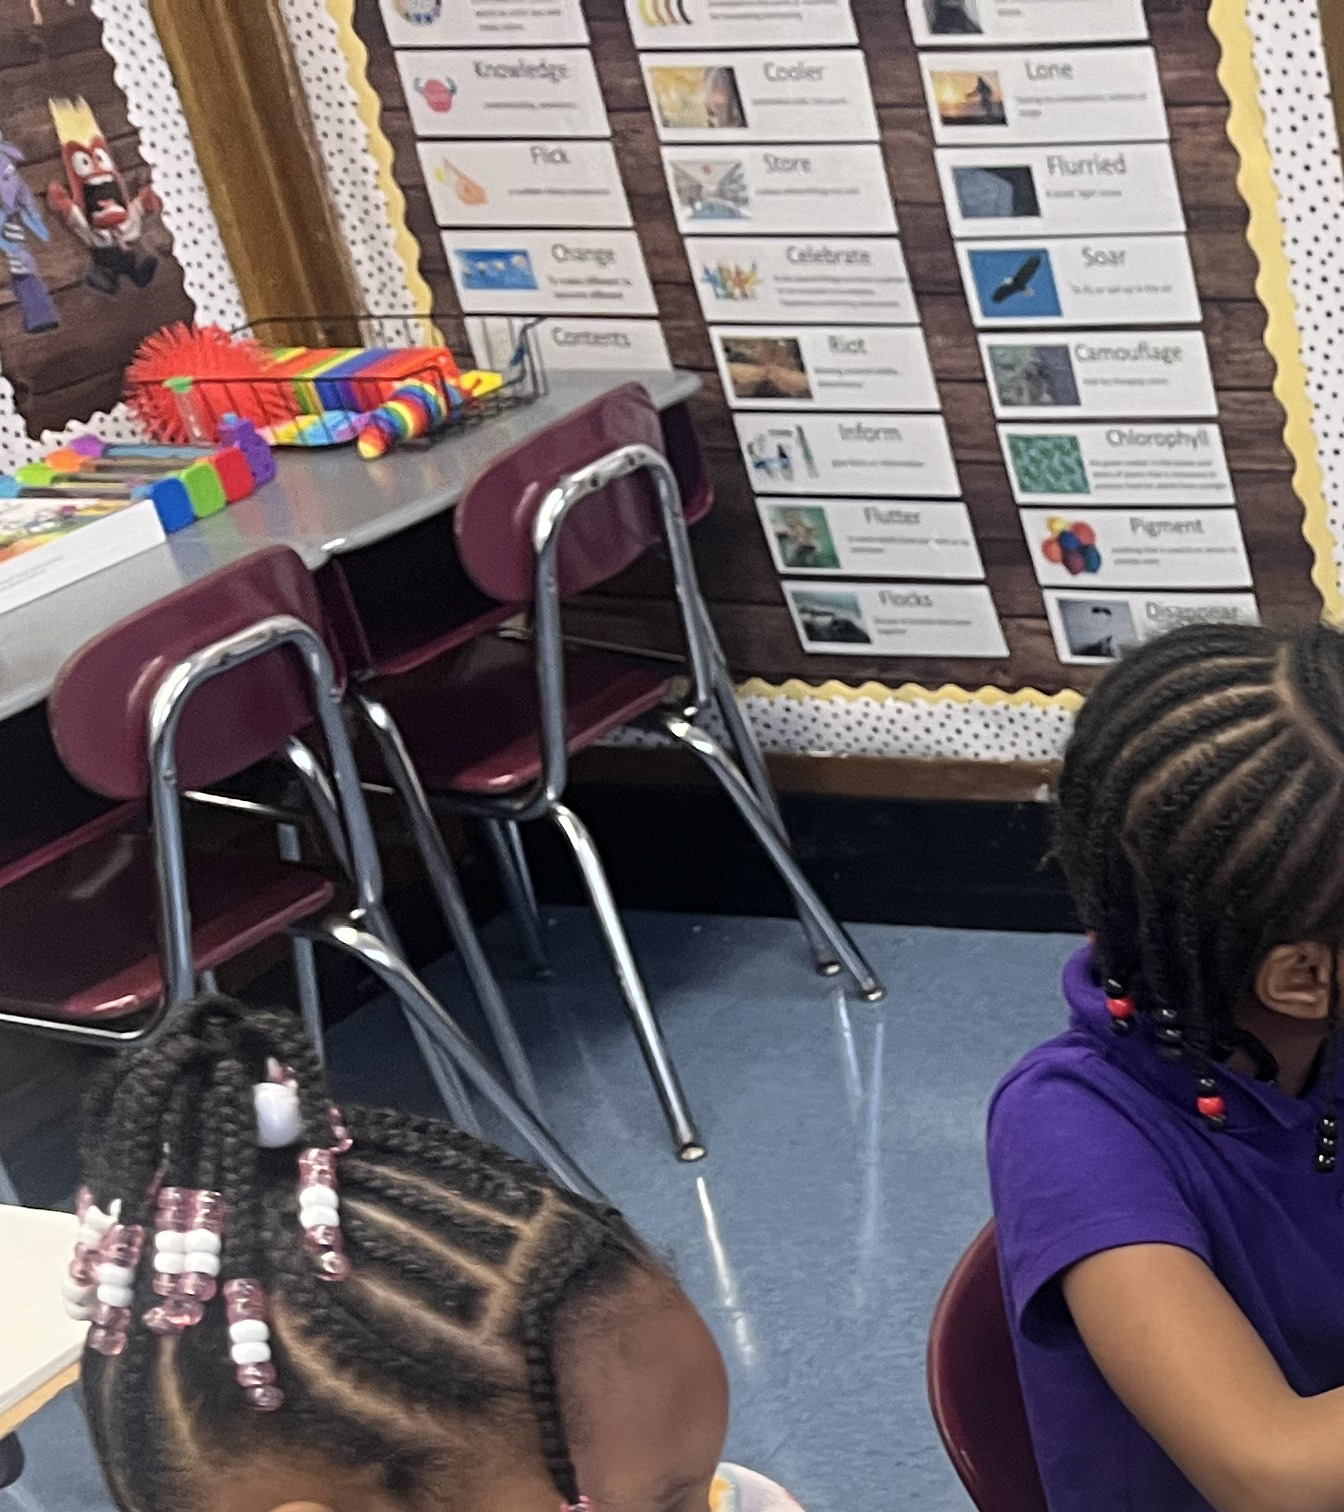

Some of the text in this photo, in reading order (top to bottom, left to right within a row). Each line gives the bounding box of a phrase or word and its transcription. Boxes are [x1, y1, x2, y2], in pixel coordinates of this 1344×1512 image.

[1024, 60, 1074, 81] Lone
[1046, 154, 1127, 176] Flurried
[551, 243, 616, 268] Change
[786, 245, 870, 266] Celebrate
[1082, 247, 1126, 267] Soar
[1074, 341, 1183, 364] Camouflage
[838, 423, 902, 443] Inform
[1106, 428, 1210, 448] Chlorophyll
[1129, 516, 1205, 537] Pigment
